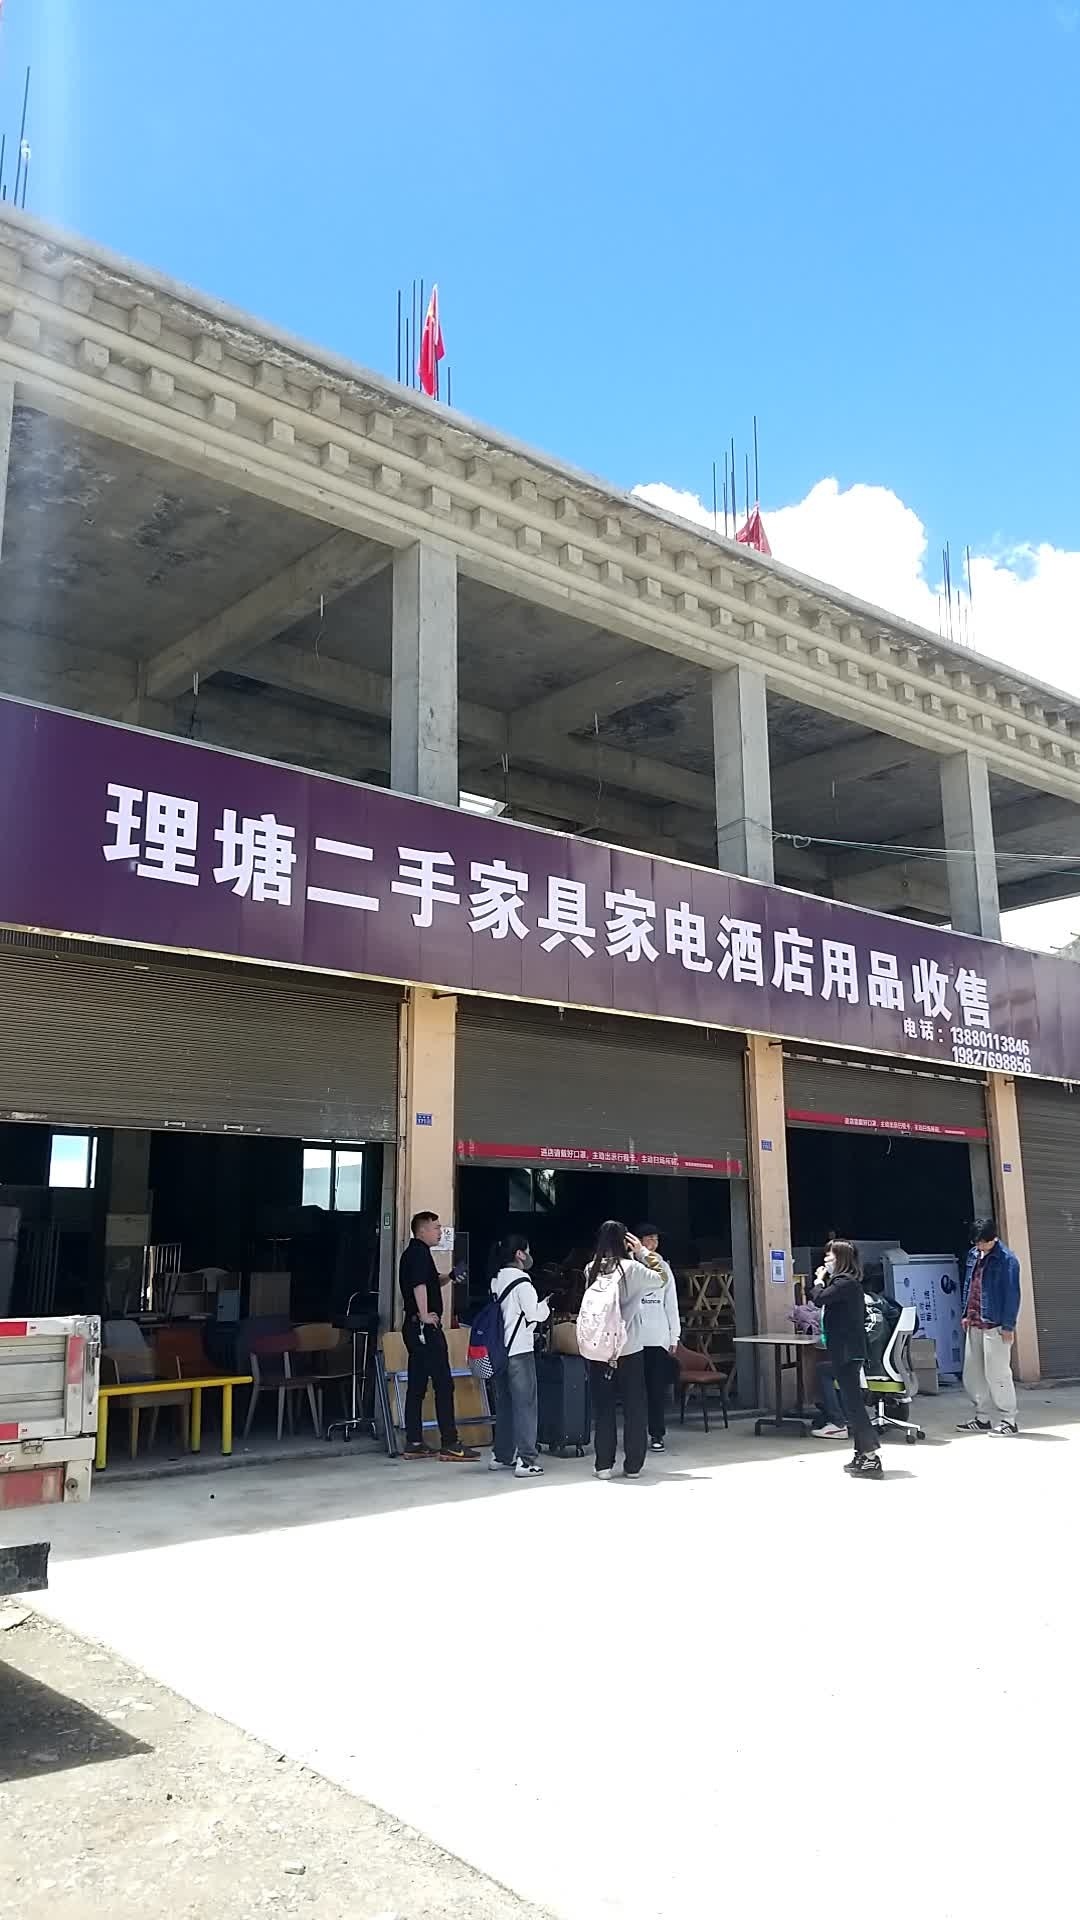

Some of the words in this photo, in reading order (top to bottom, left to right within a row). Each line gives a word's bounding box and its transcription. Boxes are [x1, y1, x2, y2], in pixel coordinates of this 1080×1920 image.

[102, 783, 991, 1028] 理塘二手家具家电酒店用品收售
[952, 1046, 1032, 1073] 19827698856
